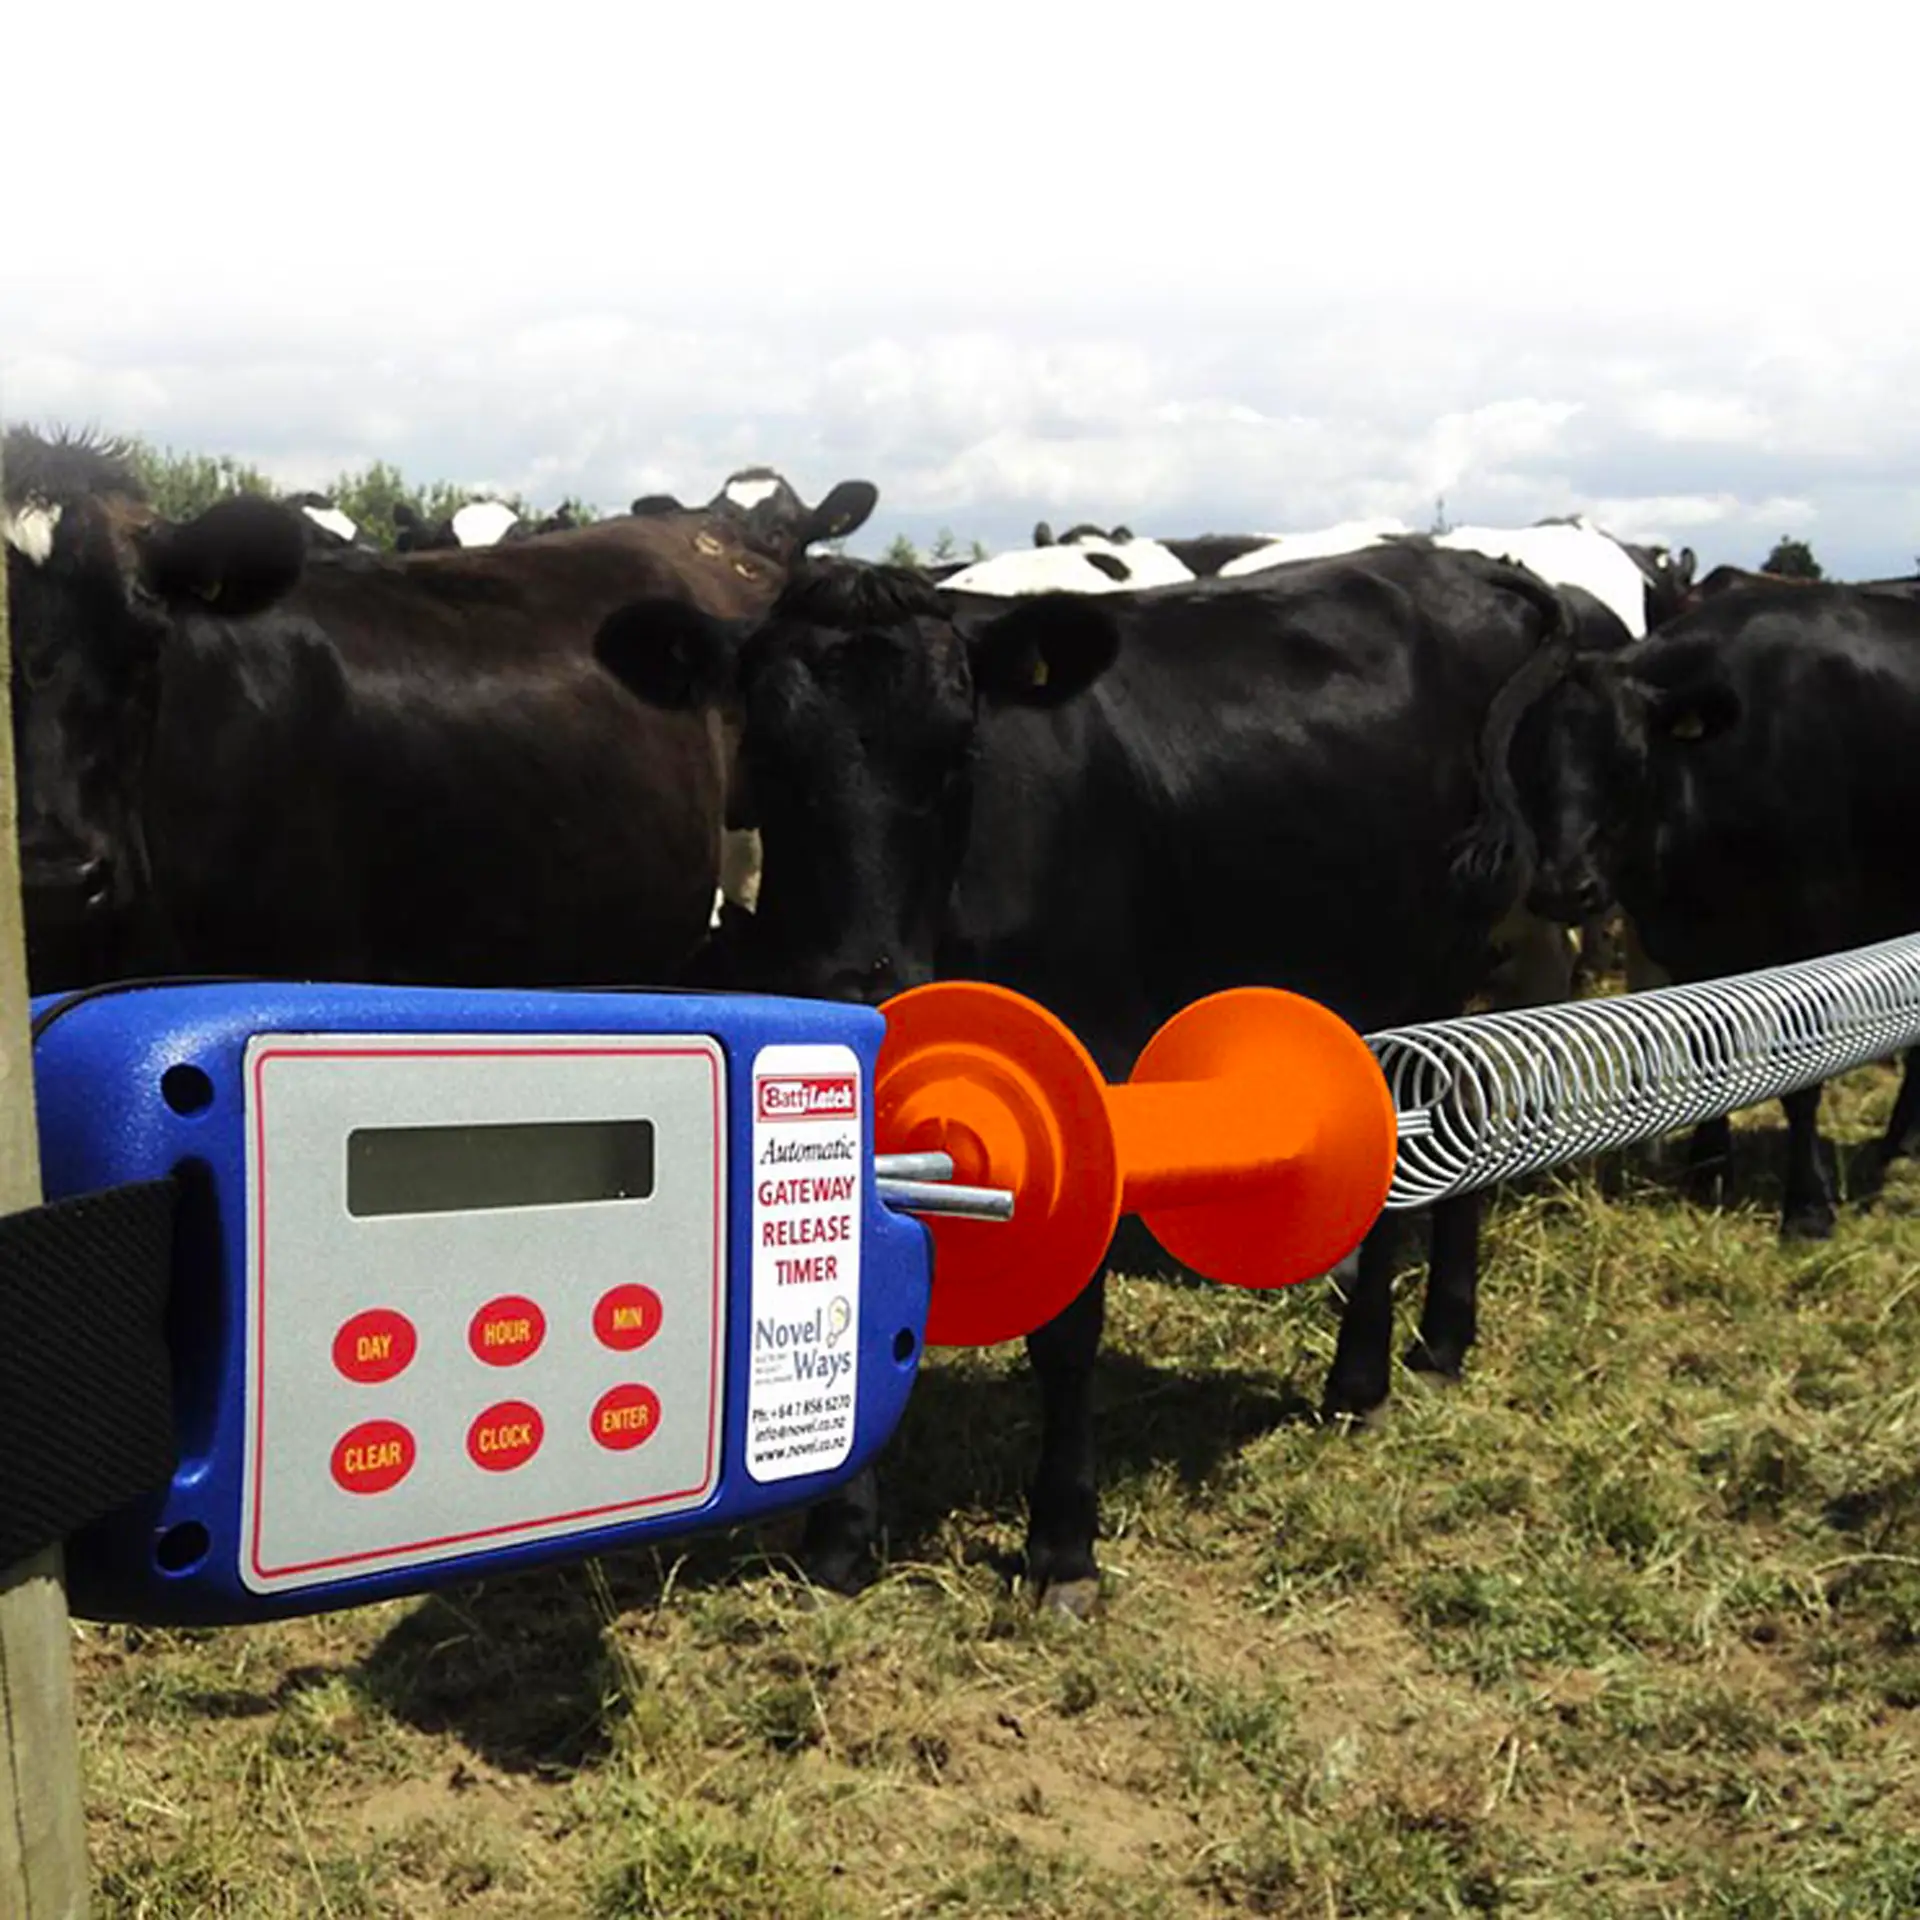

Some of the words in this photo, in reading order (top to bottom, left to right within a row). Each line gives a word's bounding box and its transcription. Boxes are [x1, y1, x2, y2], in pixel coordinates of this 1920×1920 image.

[759, 1132, 856, 1165] Automatic
[758, 1174, 855, 1207] GATEWAY
[762, 1215, 851, 1247] RELEASE
[774, 1255, 837, 1287] TIMER
[483, 1318, 531, 1347] HOUR
[612, 1307, 643, 1331] MIN
[756, 1306, 822, 1351] Novel
[356, 1334, 393, 1362] DAY
[793, 1347, 852, 1390] Ways
[601, 1404, 649, 1433] ENTER
[479, 1423, 532, 1453] CLOCK
[754, 1436, 846, 1463] www.novel.co.nz
[344, 1442, 401, 1473] CLEAR
